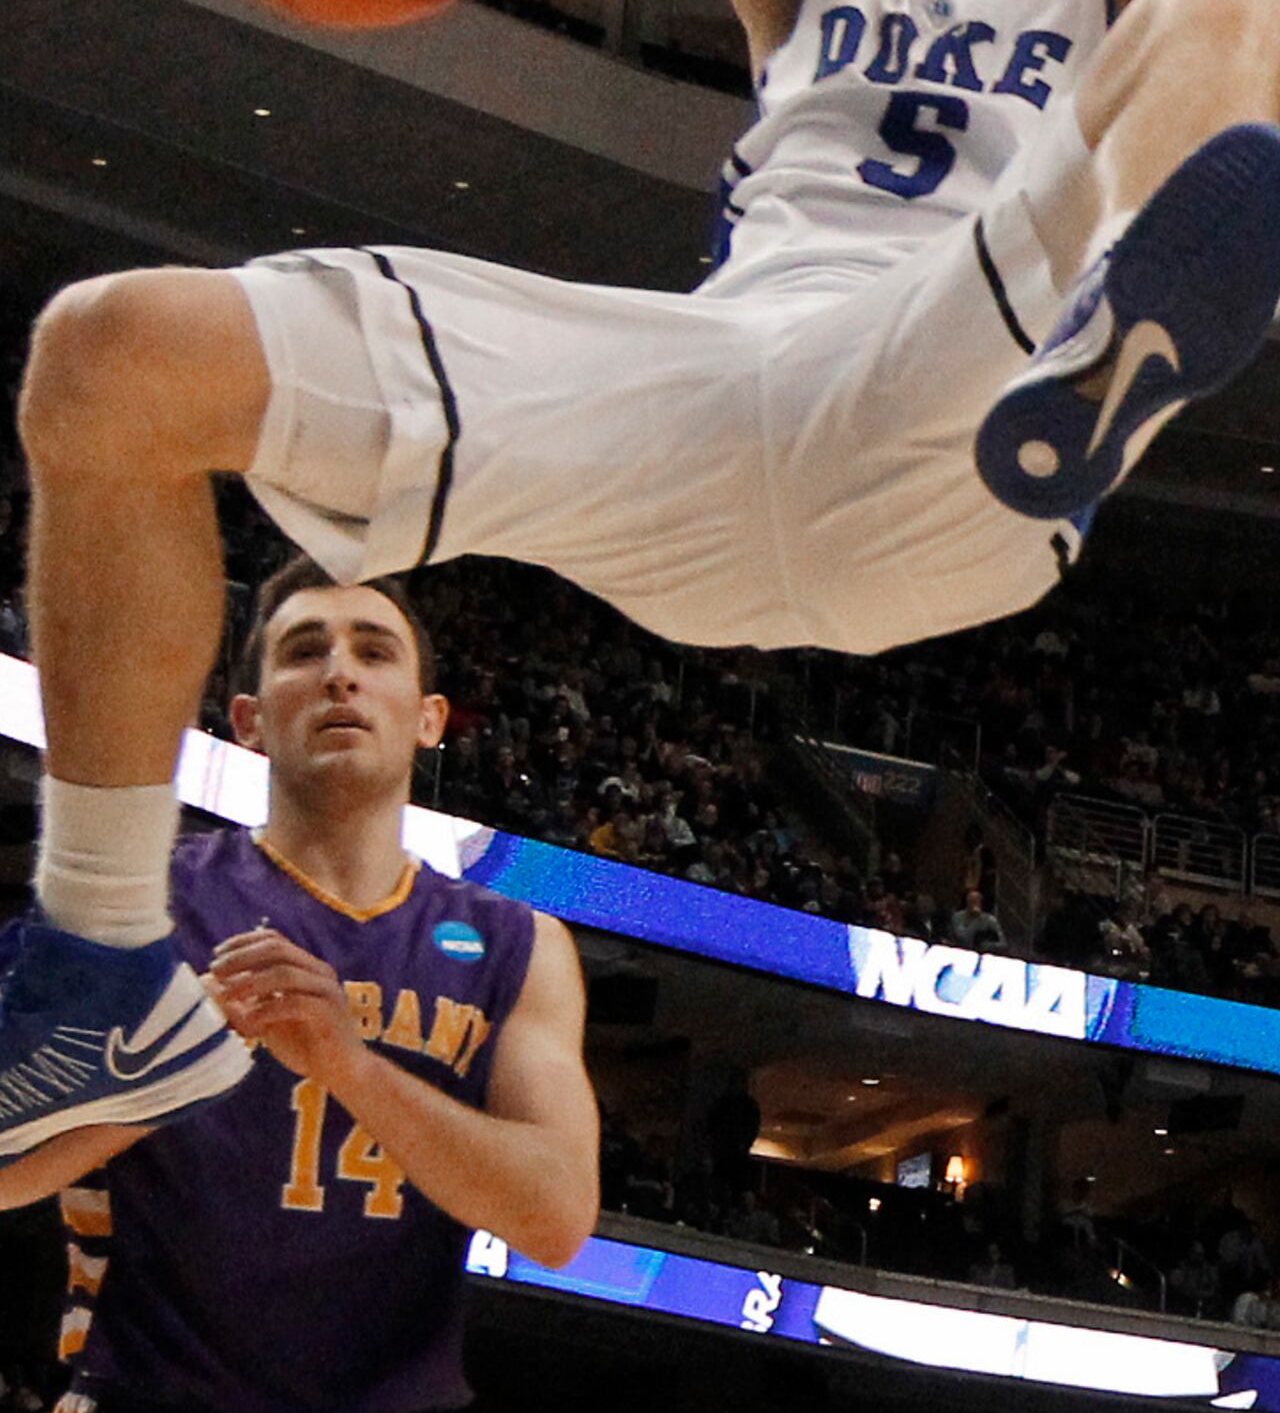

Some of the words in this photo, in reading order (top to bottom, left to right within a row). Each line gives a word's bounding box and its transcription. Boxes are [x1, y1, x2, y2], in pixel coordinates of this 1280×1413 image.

[812, 5, 1073, 110] DUKE
[856, 90, 969, 198] 5
[856, 927, 1087, 1039] NCAA
[282, 1077, 407, 1219] 14
